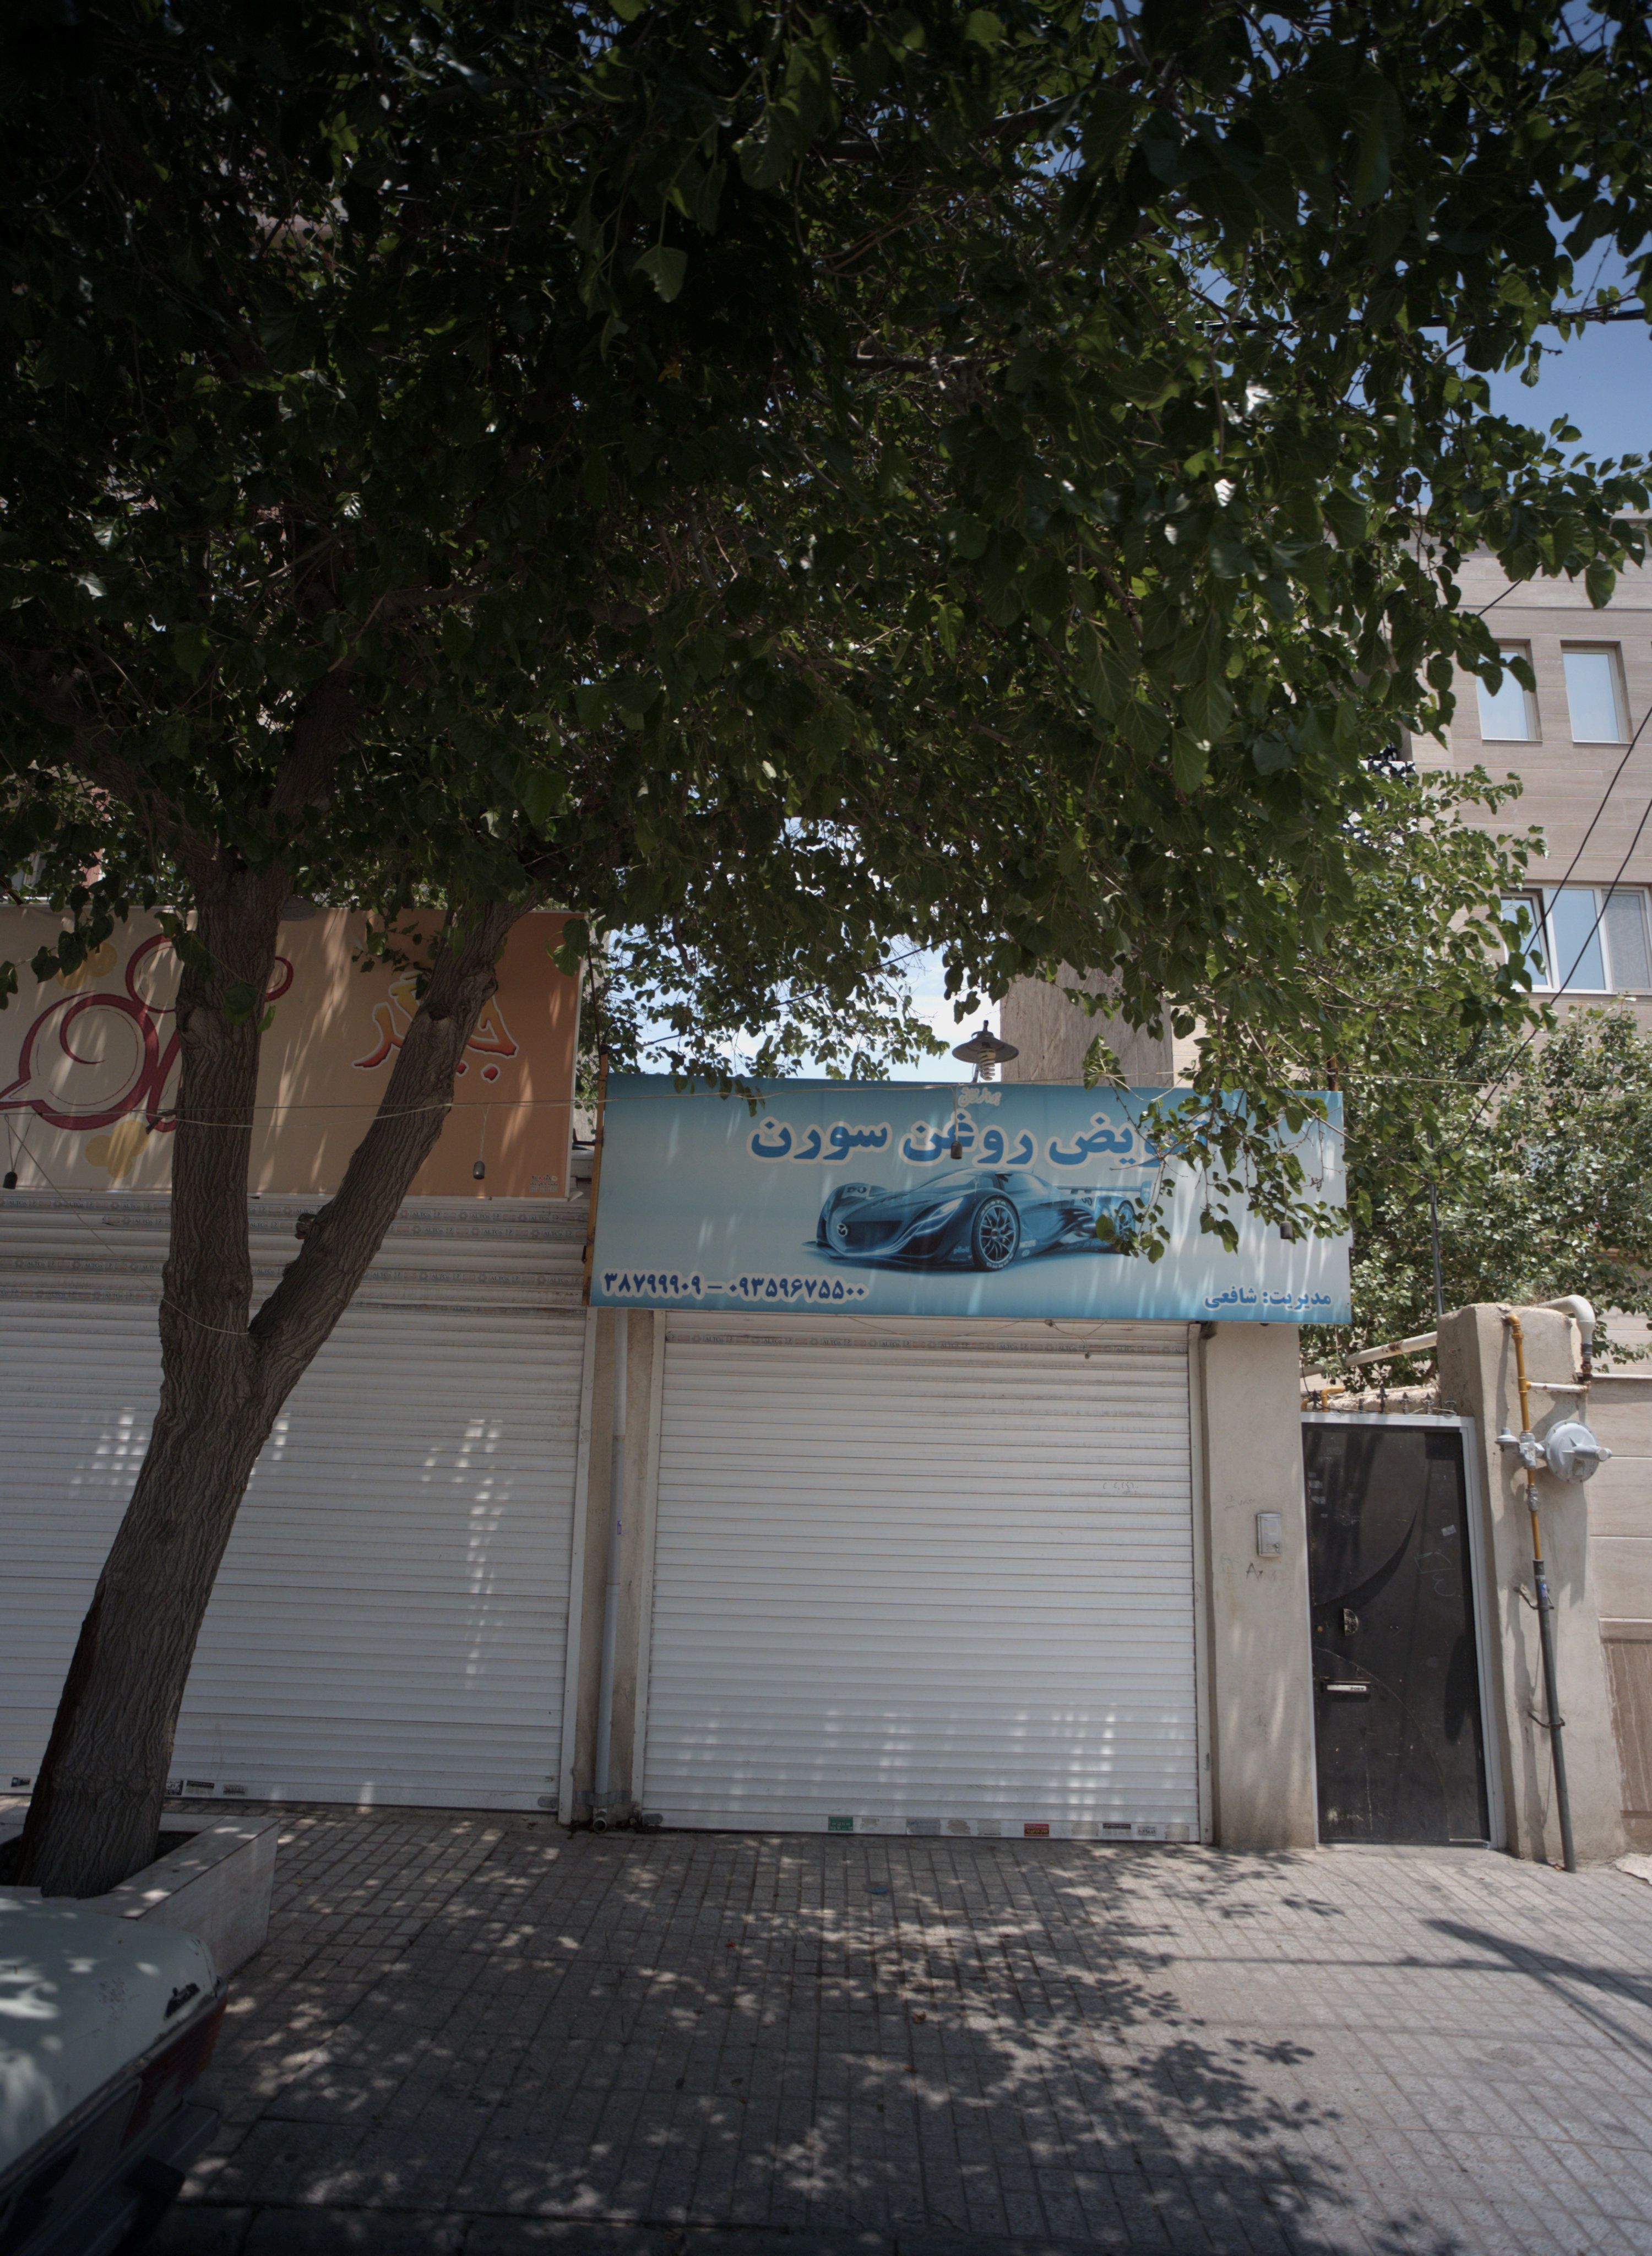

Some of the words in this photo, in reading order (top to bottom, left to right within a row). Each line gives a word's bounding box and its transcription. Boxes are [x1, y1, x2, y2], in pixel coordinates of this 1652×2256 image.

[751, 1121, 888, 1160] سورن
[903, 1113, 1034, 1164] روغن
[604, 1272, 700, 1295] ۳۸۷۹۹۹۰۹
[729, 1277, 865, 1300] ۰۹۳۵۹۶۷۵۵۰۰
[1205, 1286, 1257, 1309] شافعی
